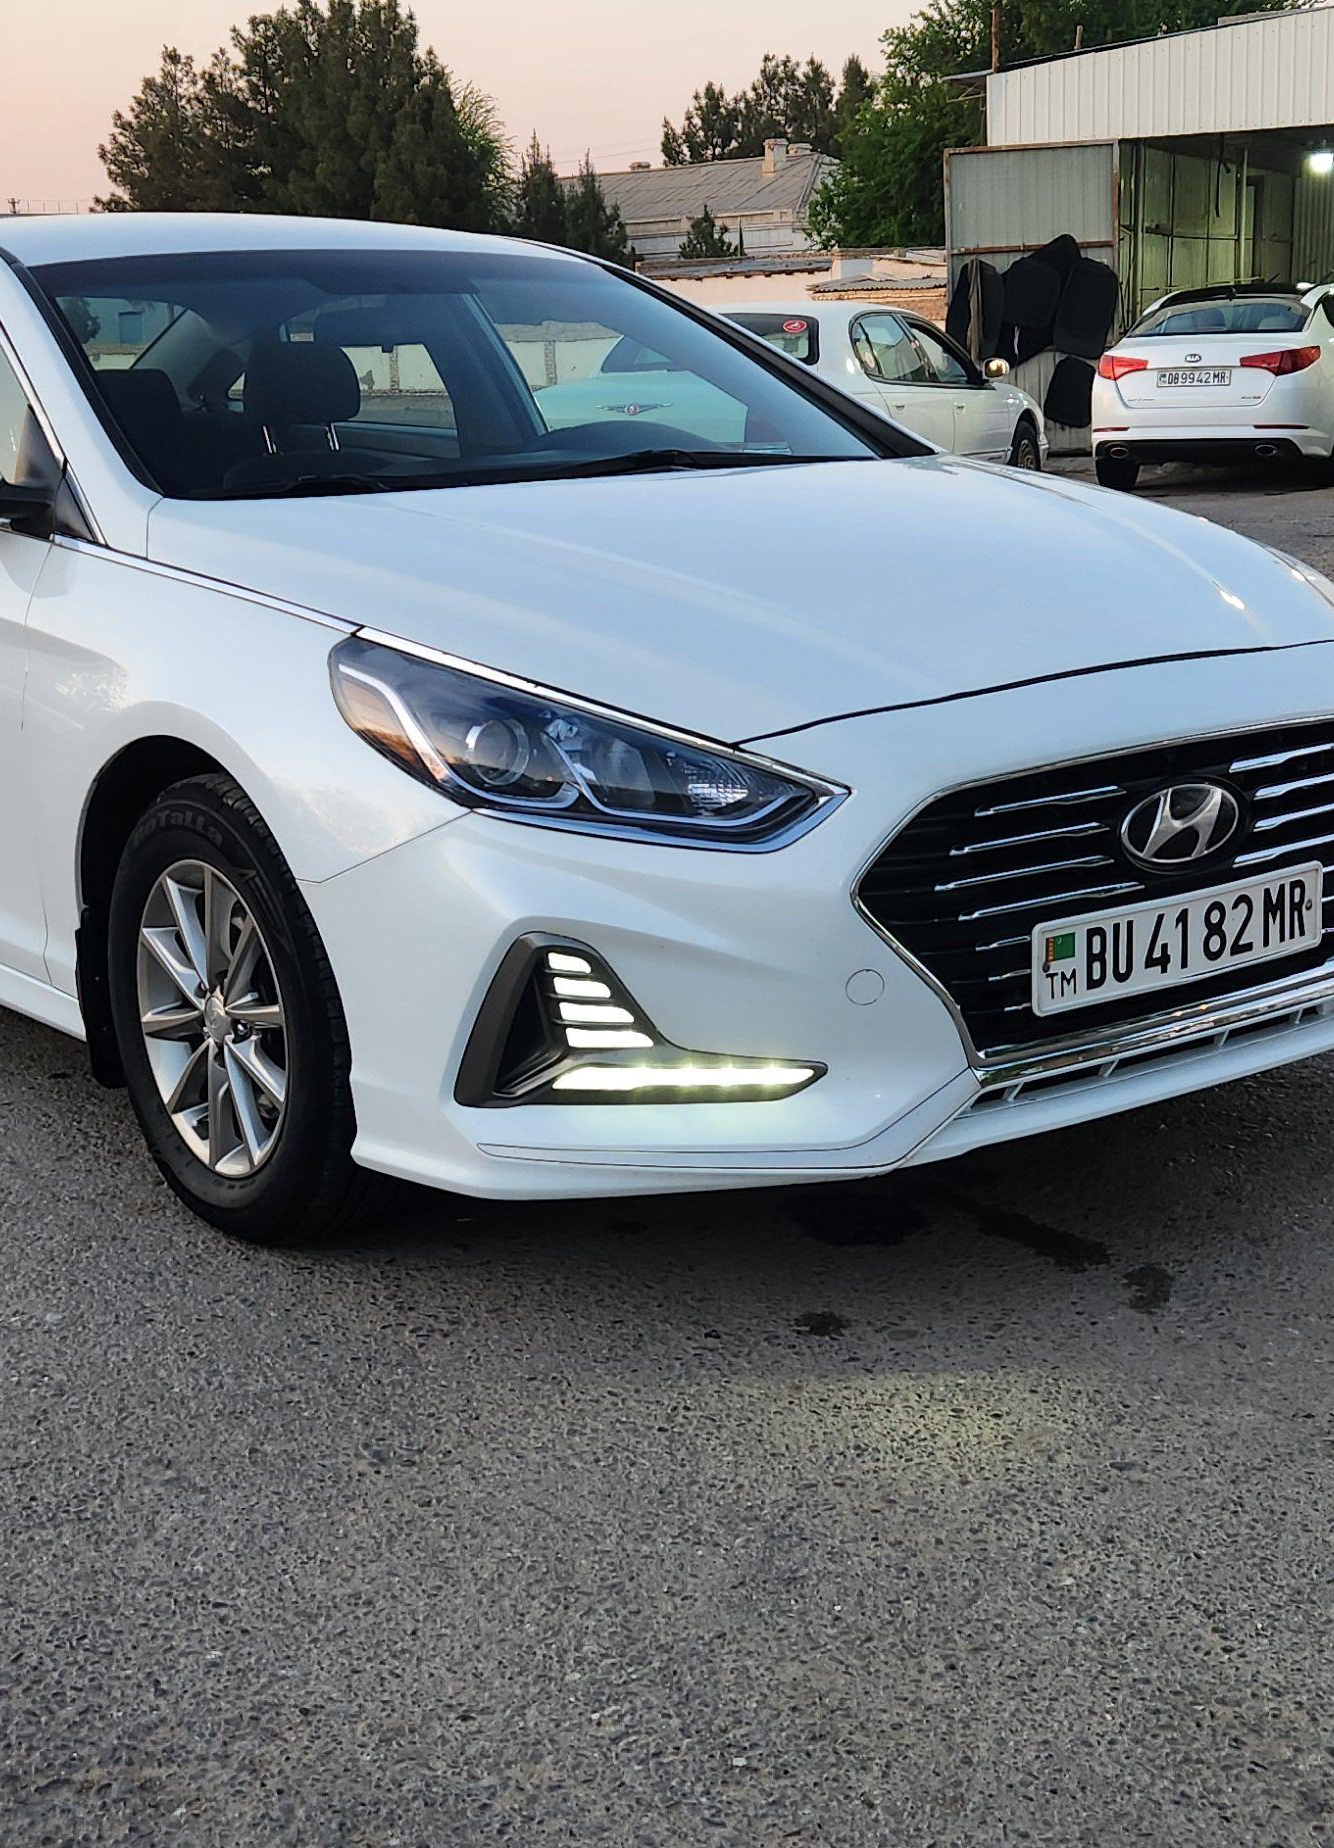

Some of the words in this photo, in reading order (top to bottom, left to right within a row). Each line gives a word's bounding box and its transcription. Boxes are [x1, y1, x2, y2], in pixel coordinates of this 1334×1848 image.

[1181, 372, 1195, 384] 99
[1196, 372, 1211, 384] 42
[1213, 371, 1226, 383] MR
[1086, 920, 1134, 991] BU
[1144, 908, 1189, 974] 41
[1202, 894, 1254, 961] 82
[1263, 879, 1306, 948] MR
[1045, 968, 1076, 999] TM
